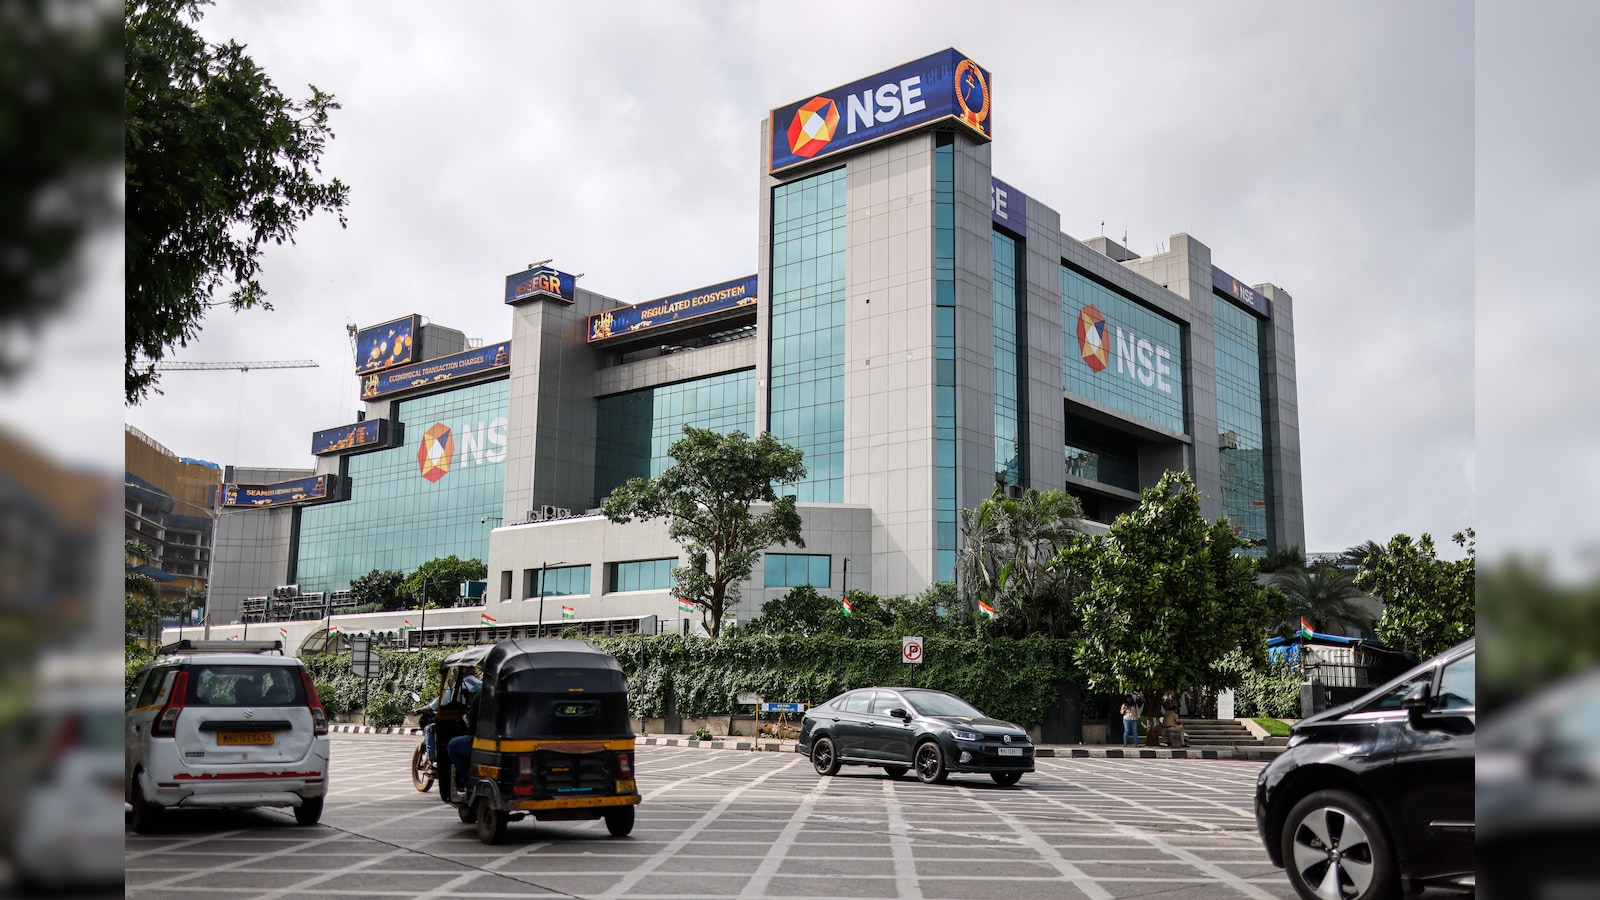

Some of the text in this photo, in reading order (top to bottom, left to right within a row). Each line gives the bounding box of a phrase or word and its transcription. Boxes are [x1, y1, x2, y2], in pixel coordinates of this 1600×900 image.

[847, 75, 926, 134] NSE
[641, 285, 746, 319] REGULATED ECOSYSTEM
[1239, 285, 1254, 306] NSE
[389, 355, 484, 383] ECONOMICAL TRANSACTION CHARGES
[1116, 326, 1172, 394] NSE
